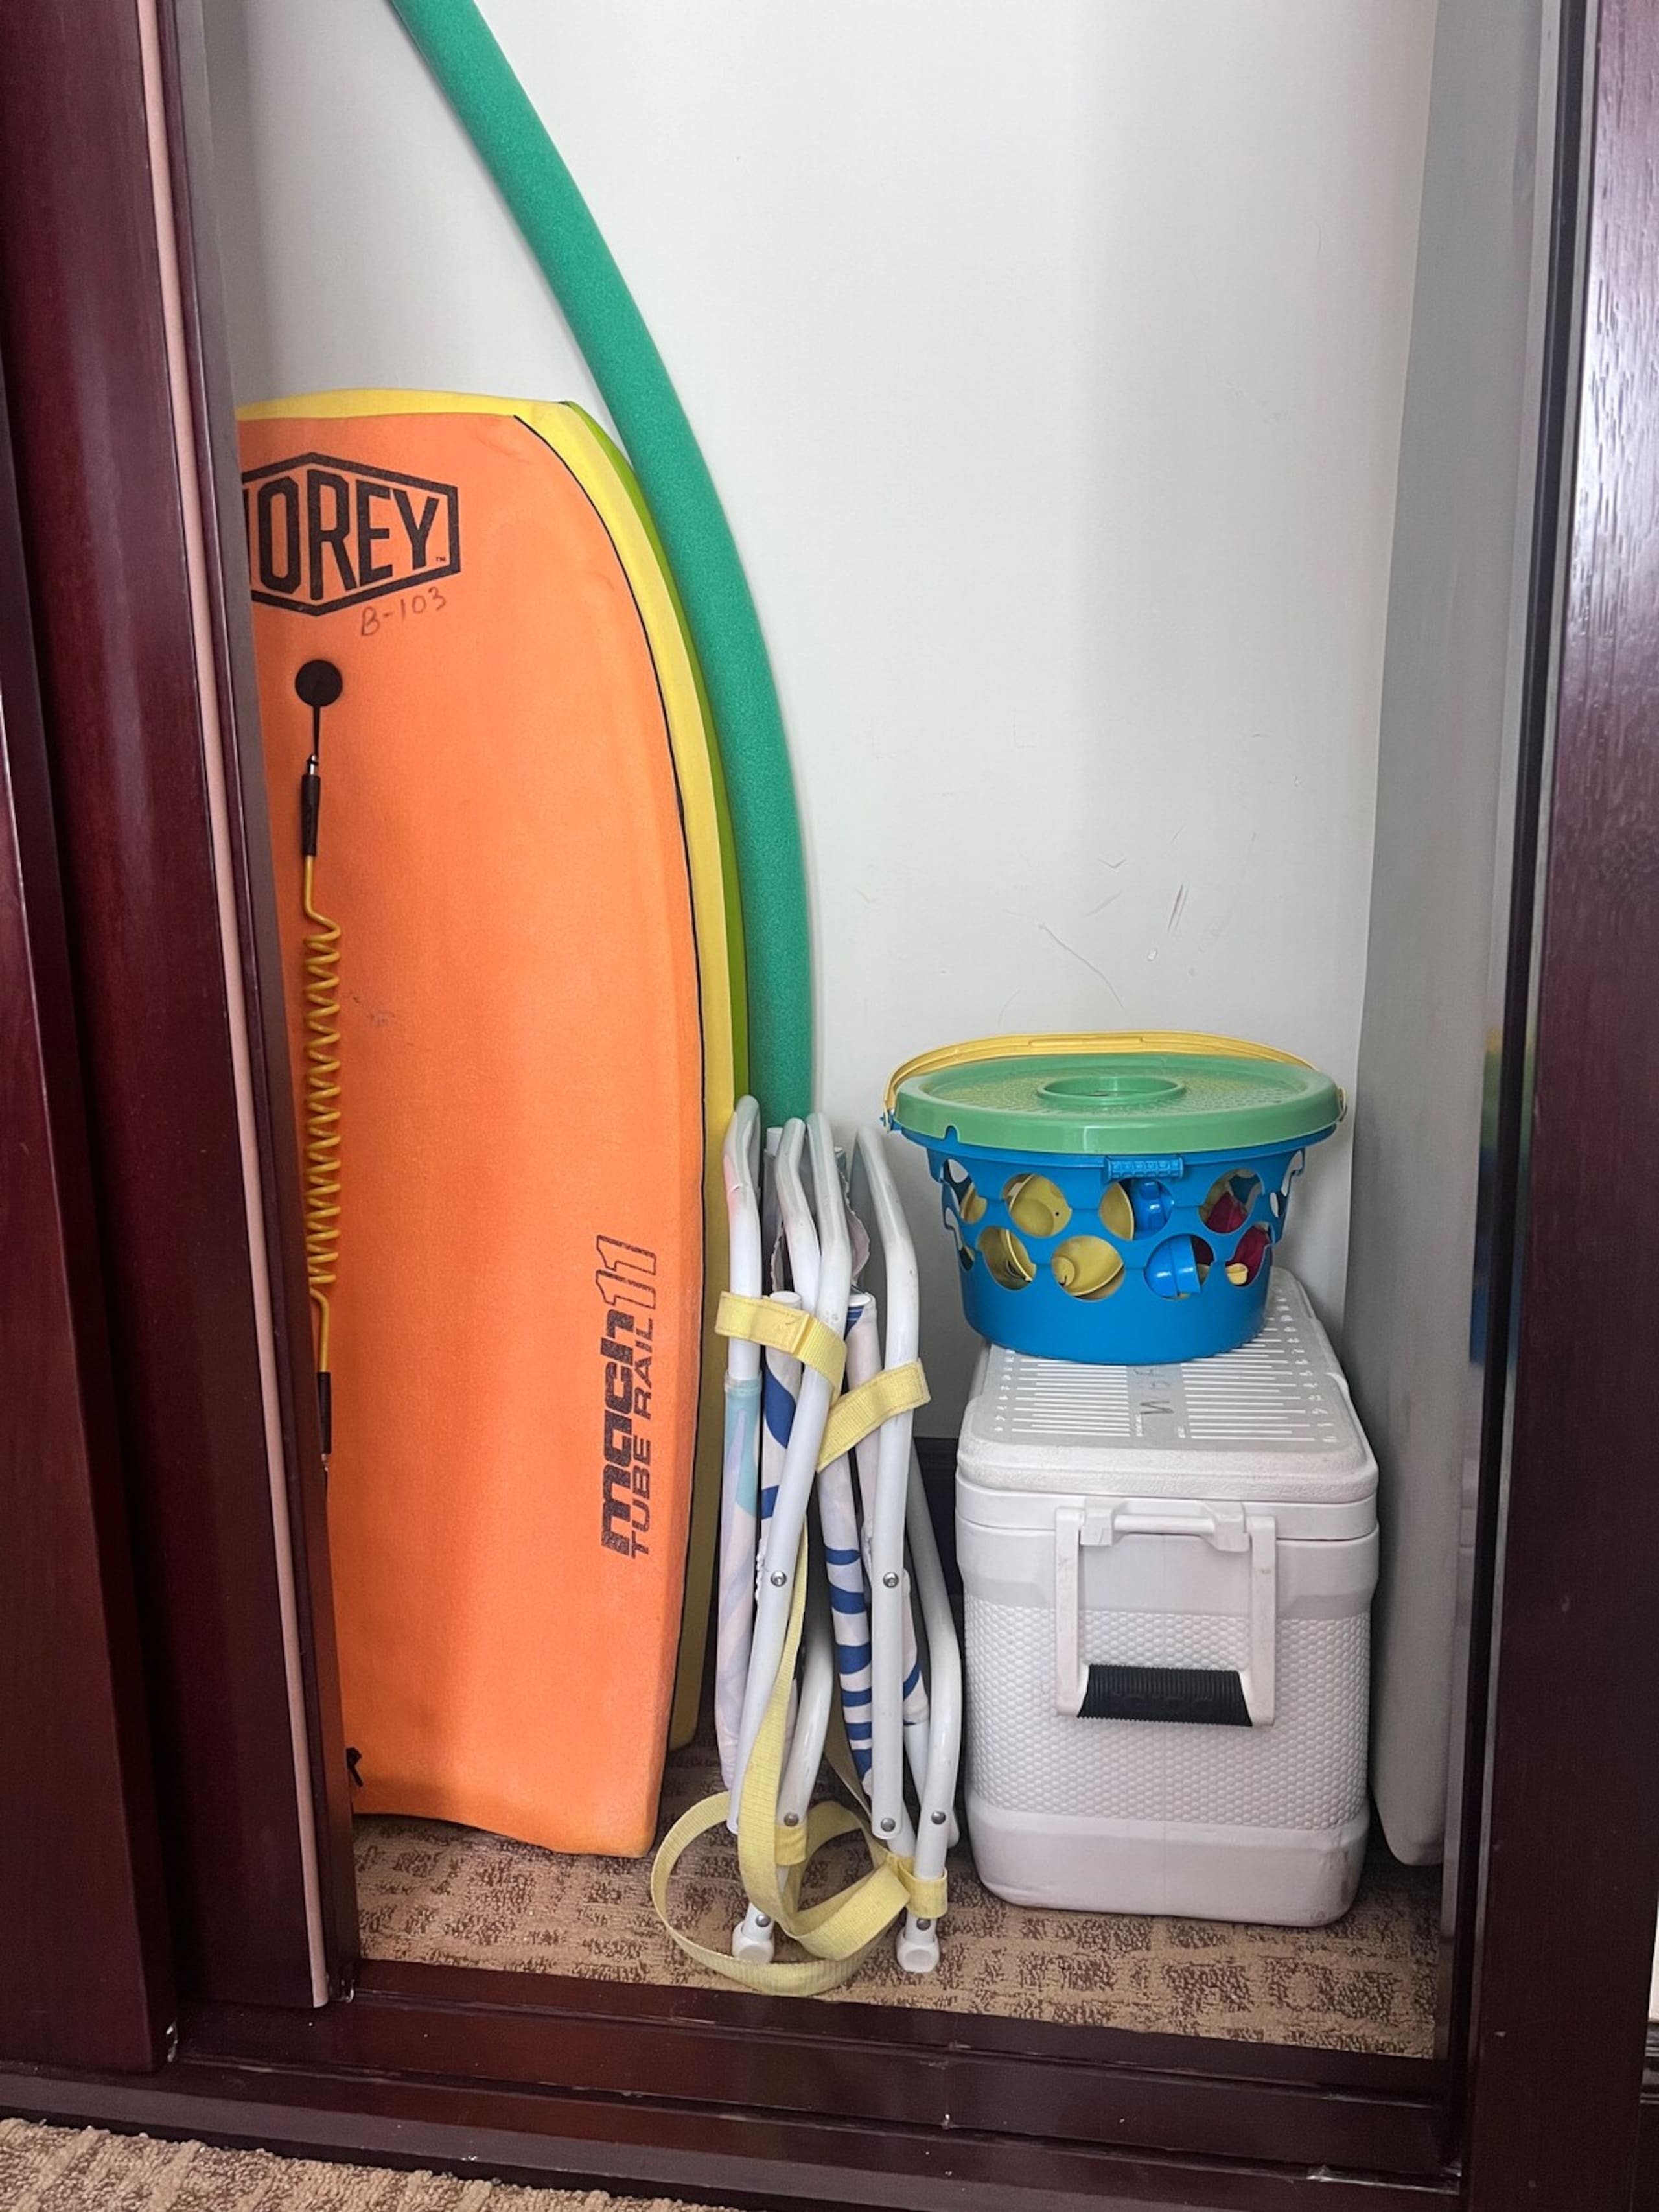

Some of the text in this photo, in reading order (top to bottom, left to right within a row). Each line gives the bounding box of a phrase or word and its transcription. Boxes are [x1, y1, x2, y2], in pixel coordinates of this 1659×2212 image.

[243, 469, 439, 600] OREY
[360, 586, 447, 636] B-103
[631, 1318, 652, 1559] TUBE RAIL
